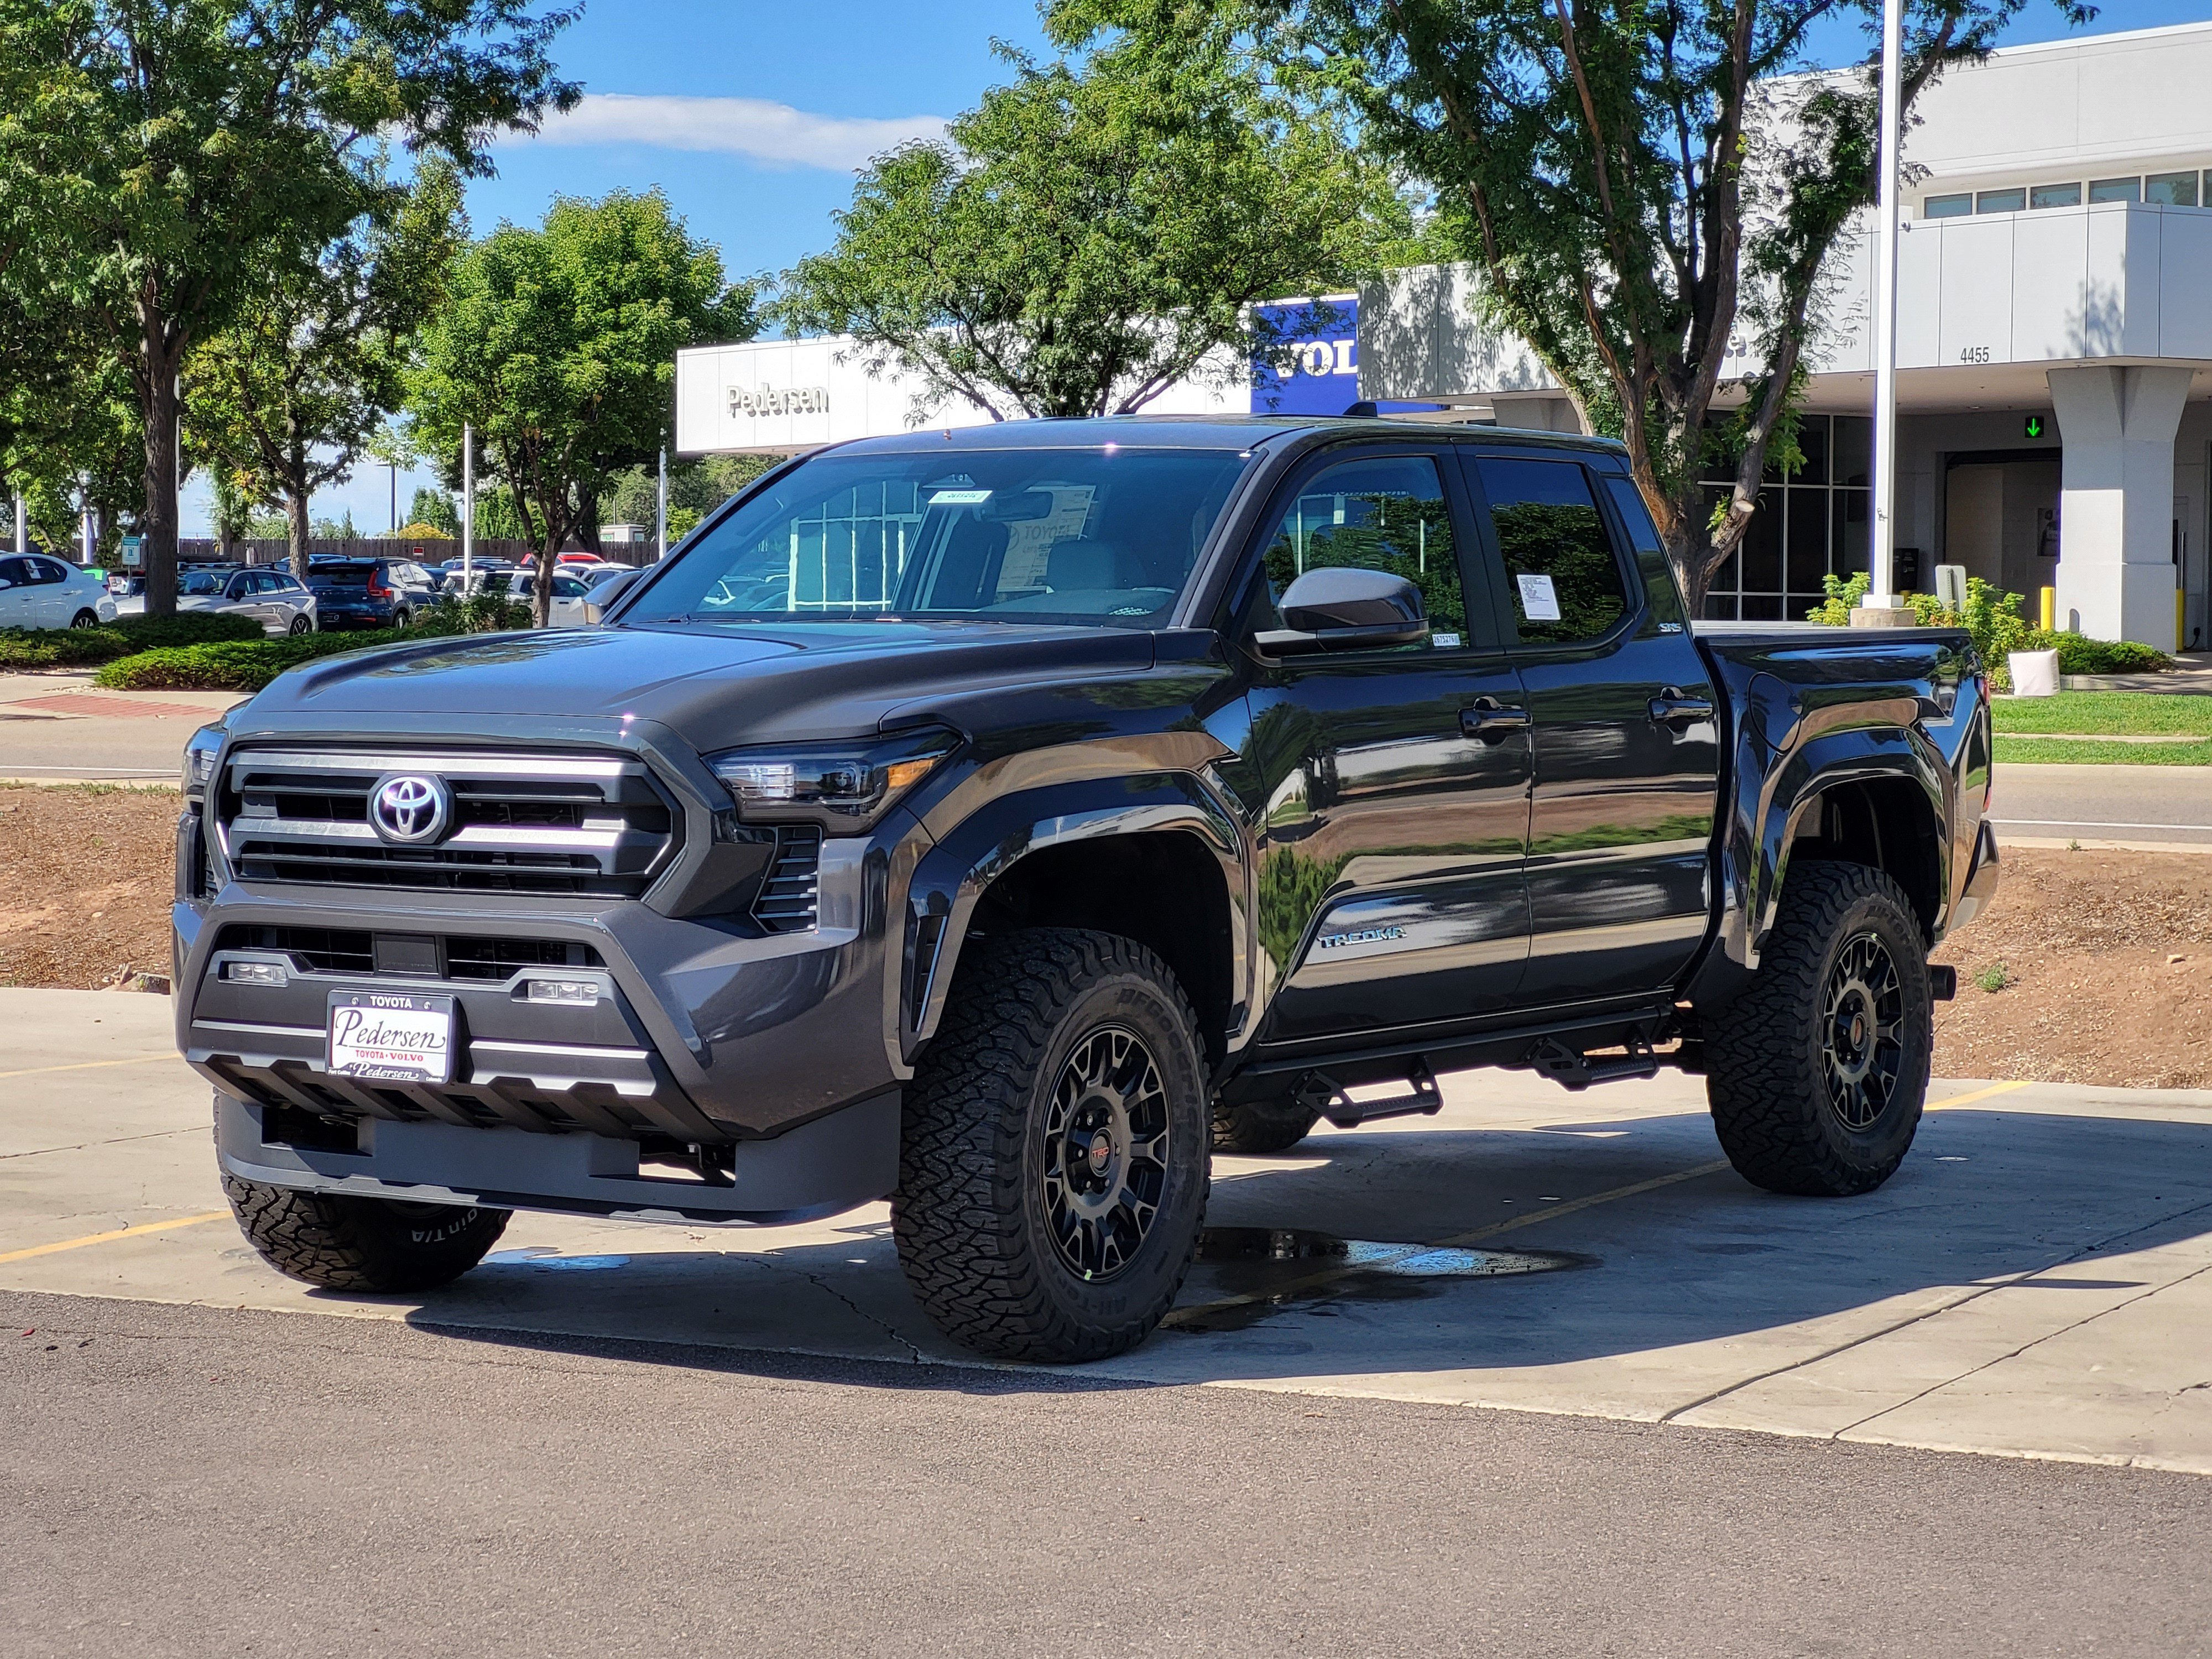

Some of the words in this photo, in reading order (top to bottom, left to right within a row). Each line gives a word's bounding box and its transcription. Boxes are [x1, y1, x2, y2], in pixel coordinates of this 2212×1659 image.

[1960, 347, 1989, 363] 4455
[727, 383, 828, 417] Pedersen
[1658, 623, 1682, 632] SR5
[1318, 926, 1408, 948] TACOMA
[369, 995, 413, 1009] TOYOTA
[335, 1009, 446, 1048] Pedersen
[355, 1050, 384, 1060] TOYOTA
[390, 1052, 424, 1062] VOLVO
[352, 1061, 420, 1079] Pedersen
[1092, 1146, 1109, 1159] TRD
